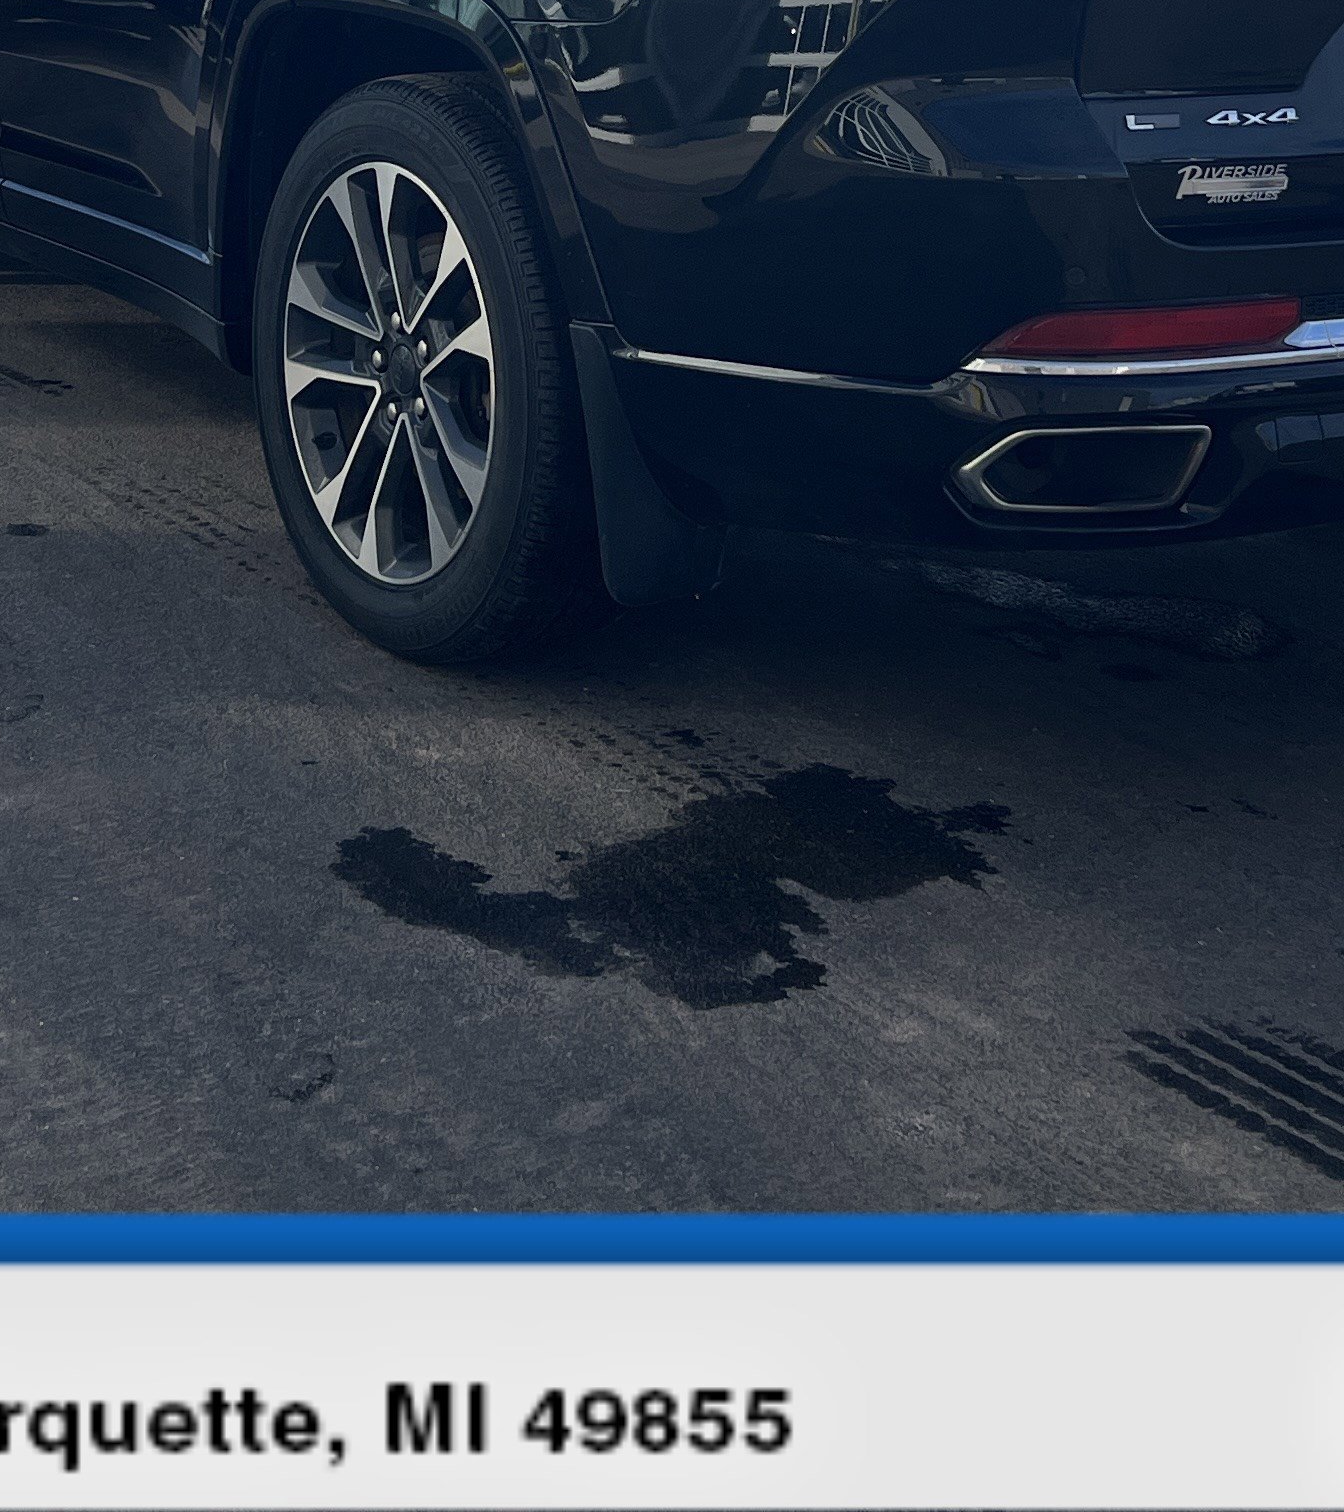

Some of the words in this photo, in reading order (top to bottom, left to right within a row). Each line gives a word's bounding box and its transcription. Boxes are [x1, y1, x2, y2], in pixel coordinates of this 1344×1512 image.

[1206, 107, 1300, 127] 4x4
[1176, 163, 1289, 200] RIVERSIDE
[1207, 191, 1241, 204] AUTO
[1242, 190, 1281, 202] SALES
